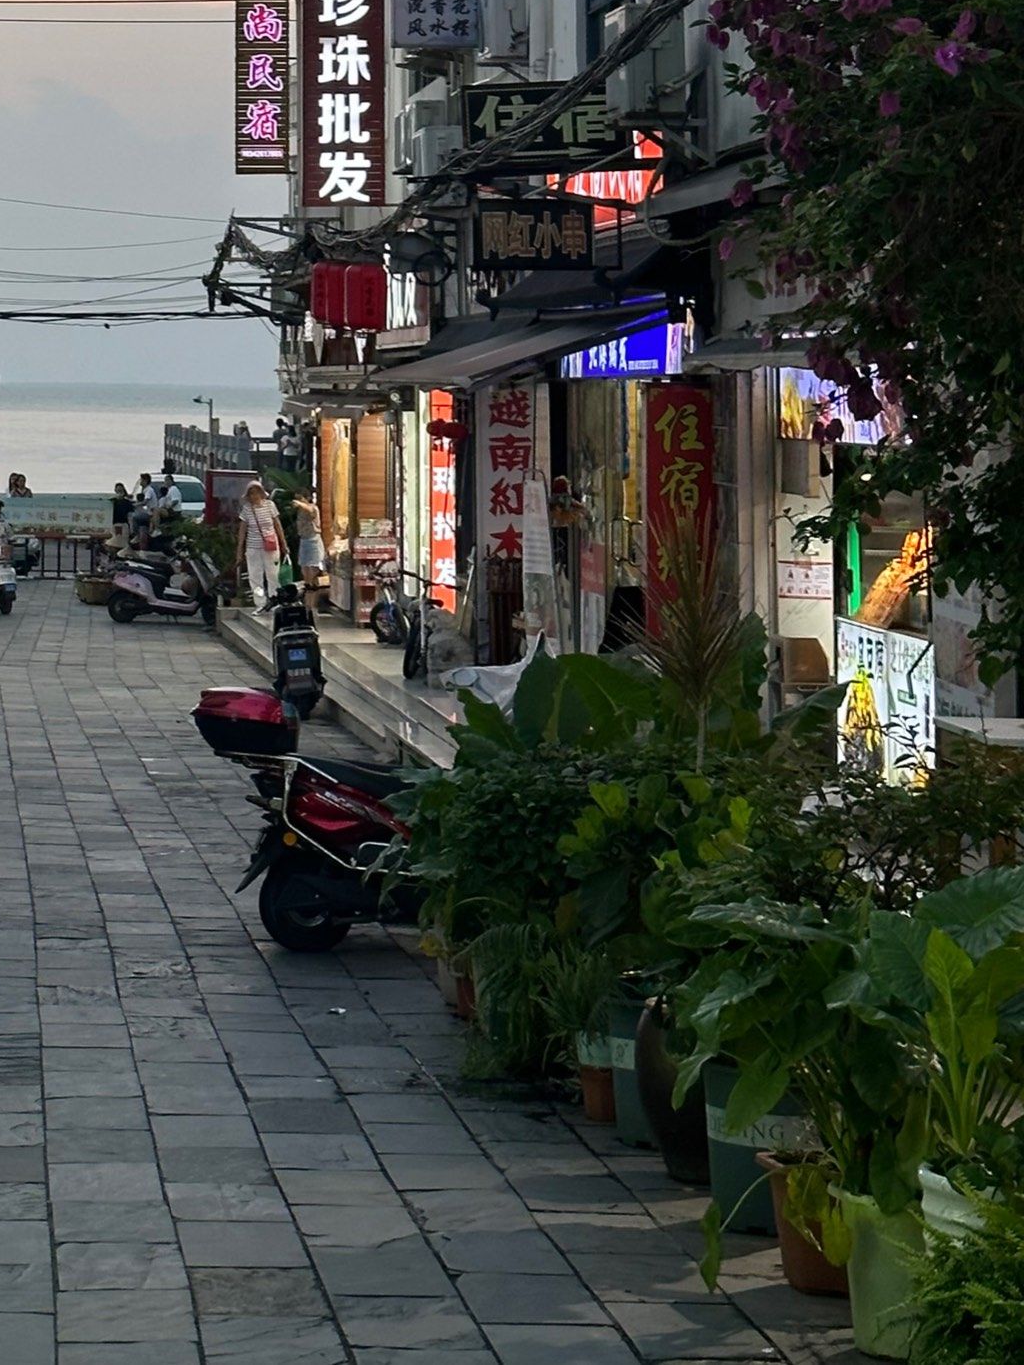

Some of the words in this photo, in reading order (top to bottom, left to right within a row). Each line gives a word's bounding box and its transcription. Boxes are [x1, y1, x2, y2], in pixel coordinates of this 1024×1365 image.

[482, 209, 587, 259] 网红小串
[654, 403, 705, 582] 住宿
